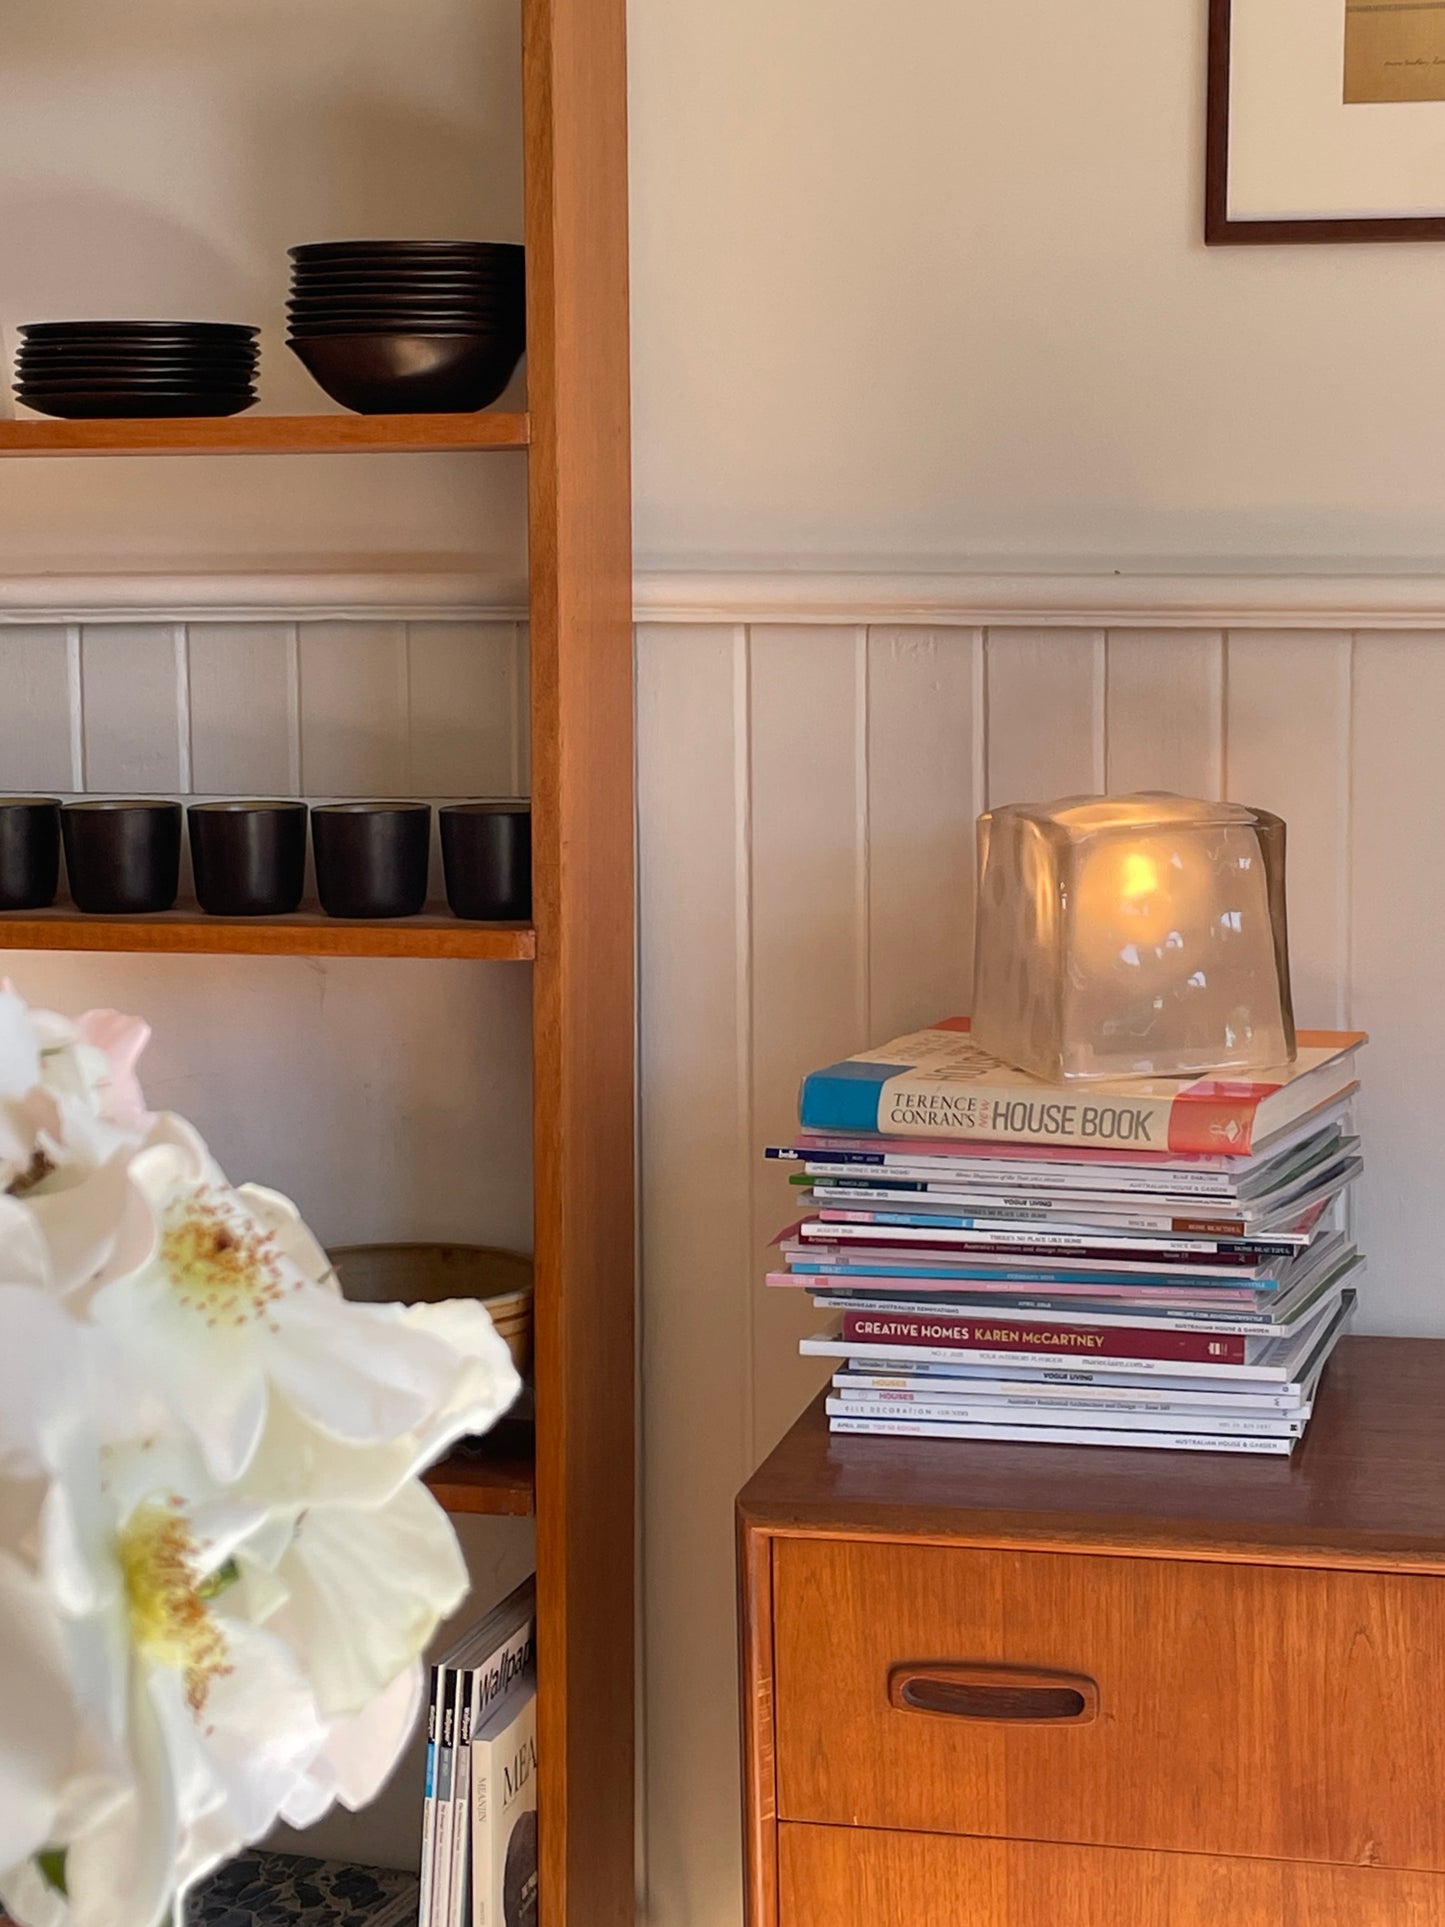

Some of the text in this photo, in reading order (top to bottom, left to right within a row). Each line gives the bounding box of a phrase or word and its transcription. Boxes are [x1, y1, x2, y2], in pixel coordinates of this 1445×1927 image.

[893, 1092, 977, 1112] TERENCE
[890, 1109, 976, 1128] CONRAN'S
[978, 1098, 991, 1129] NEW
[992, 1100, 1154, 1142] HOUSE BOOK
[1029, 1200, 1053, 1208] LIVING
[989, 1233, 1016, 1242] THERE'S
[963, 1243, 995, 1251] Australia's
[828, 1301, 960, 1315] CONTEMPORARY AUSTRALIAN RENOVATIONS
[1174, 1323, 1214, 1331] AUSTRALIAN
[1214, 1325, 1237, 1333] HOUSE
[855, 1321, 1105, 1348] CREATIVE HOMES KAREN McCARTNEY
[1043, 1372, 1094, 1382] VOGUE LIVING
[871, 1379, 908, 1388] HOUSES
[879, 1391, 915, 1400] HOUSES
[845, 1405, 865, 1414] ELLE
[870, 1407, 932, 1416] DECORATION
[1175, 1438, 1216, 1446] AUSTRALIAN
[476, 1777, 487, 1823] MEANJIN
